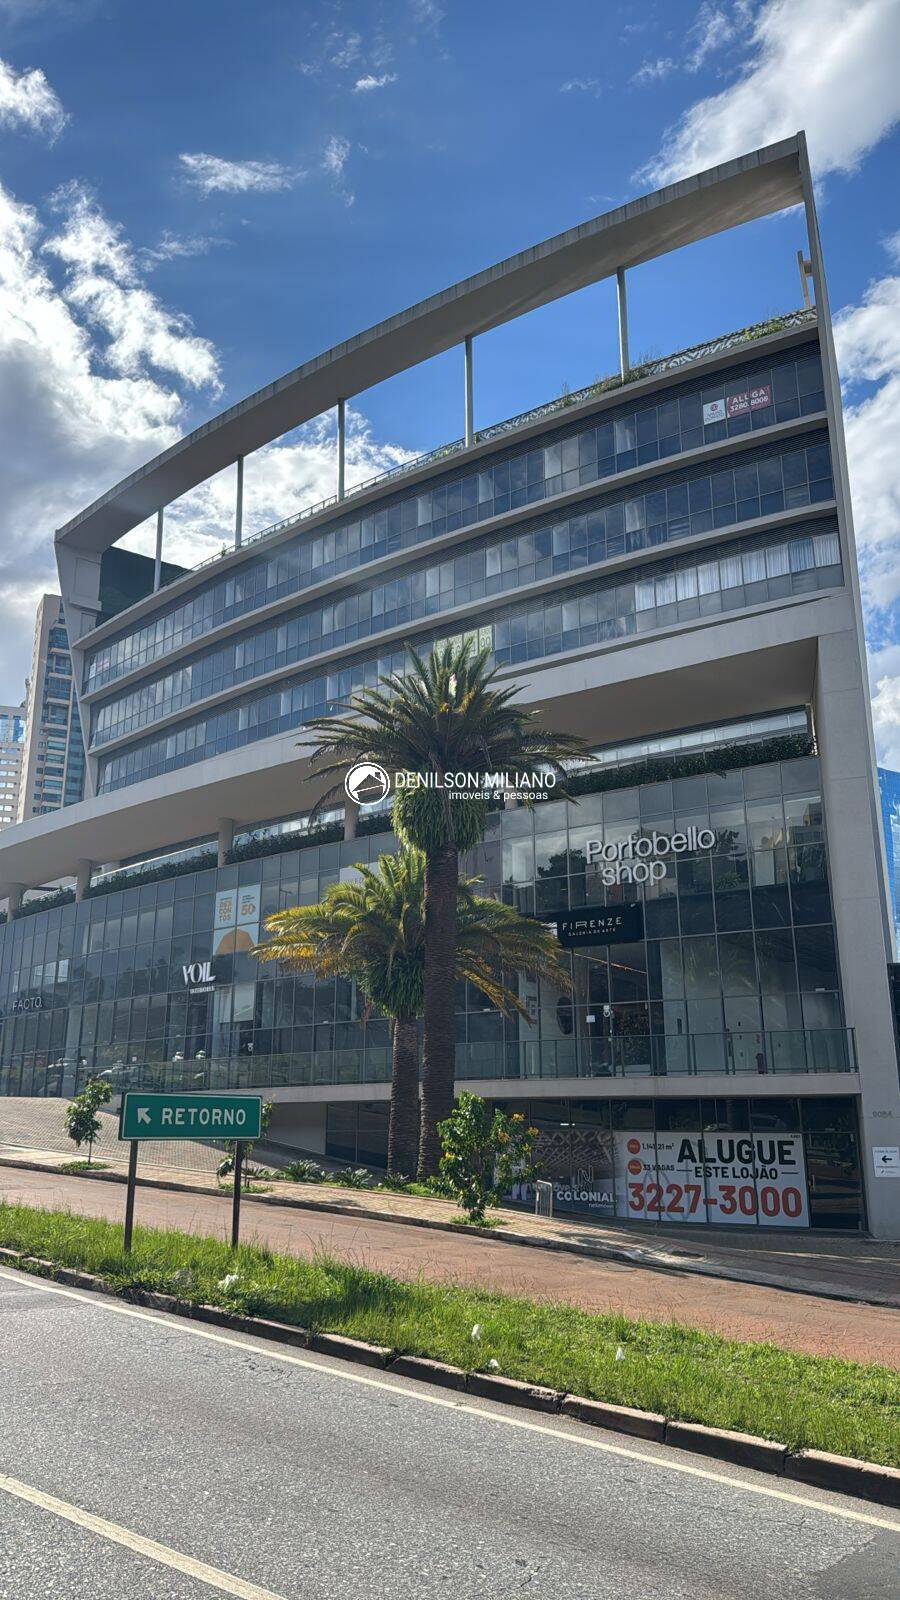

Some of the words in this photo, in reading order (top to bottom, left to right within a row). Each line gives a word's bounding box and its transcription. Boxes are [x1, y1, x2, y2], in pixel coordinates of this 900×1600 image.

[586, 825, 716, 864] Portobello
[602, 861, 667, 886] shop
[562, 916, 622, 931] FIRENZE
[161, 1107, 246, 1125] RETORNO
[677, 1138, 796, 1165] ALUGUE
[695, 1166, 729, 1178] ESTE
[732, 1165, 778, 1180] LOJÃO
[628, 1182, 802, 1218] 3227-3000
